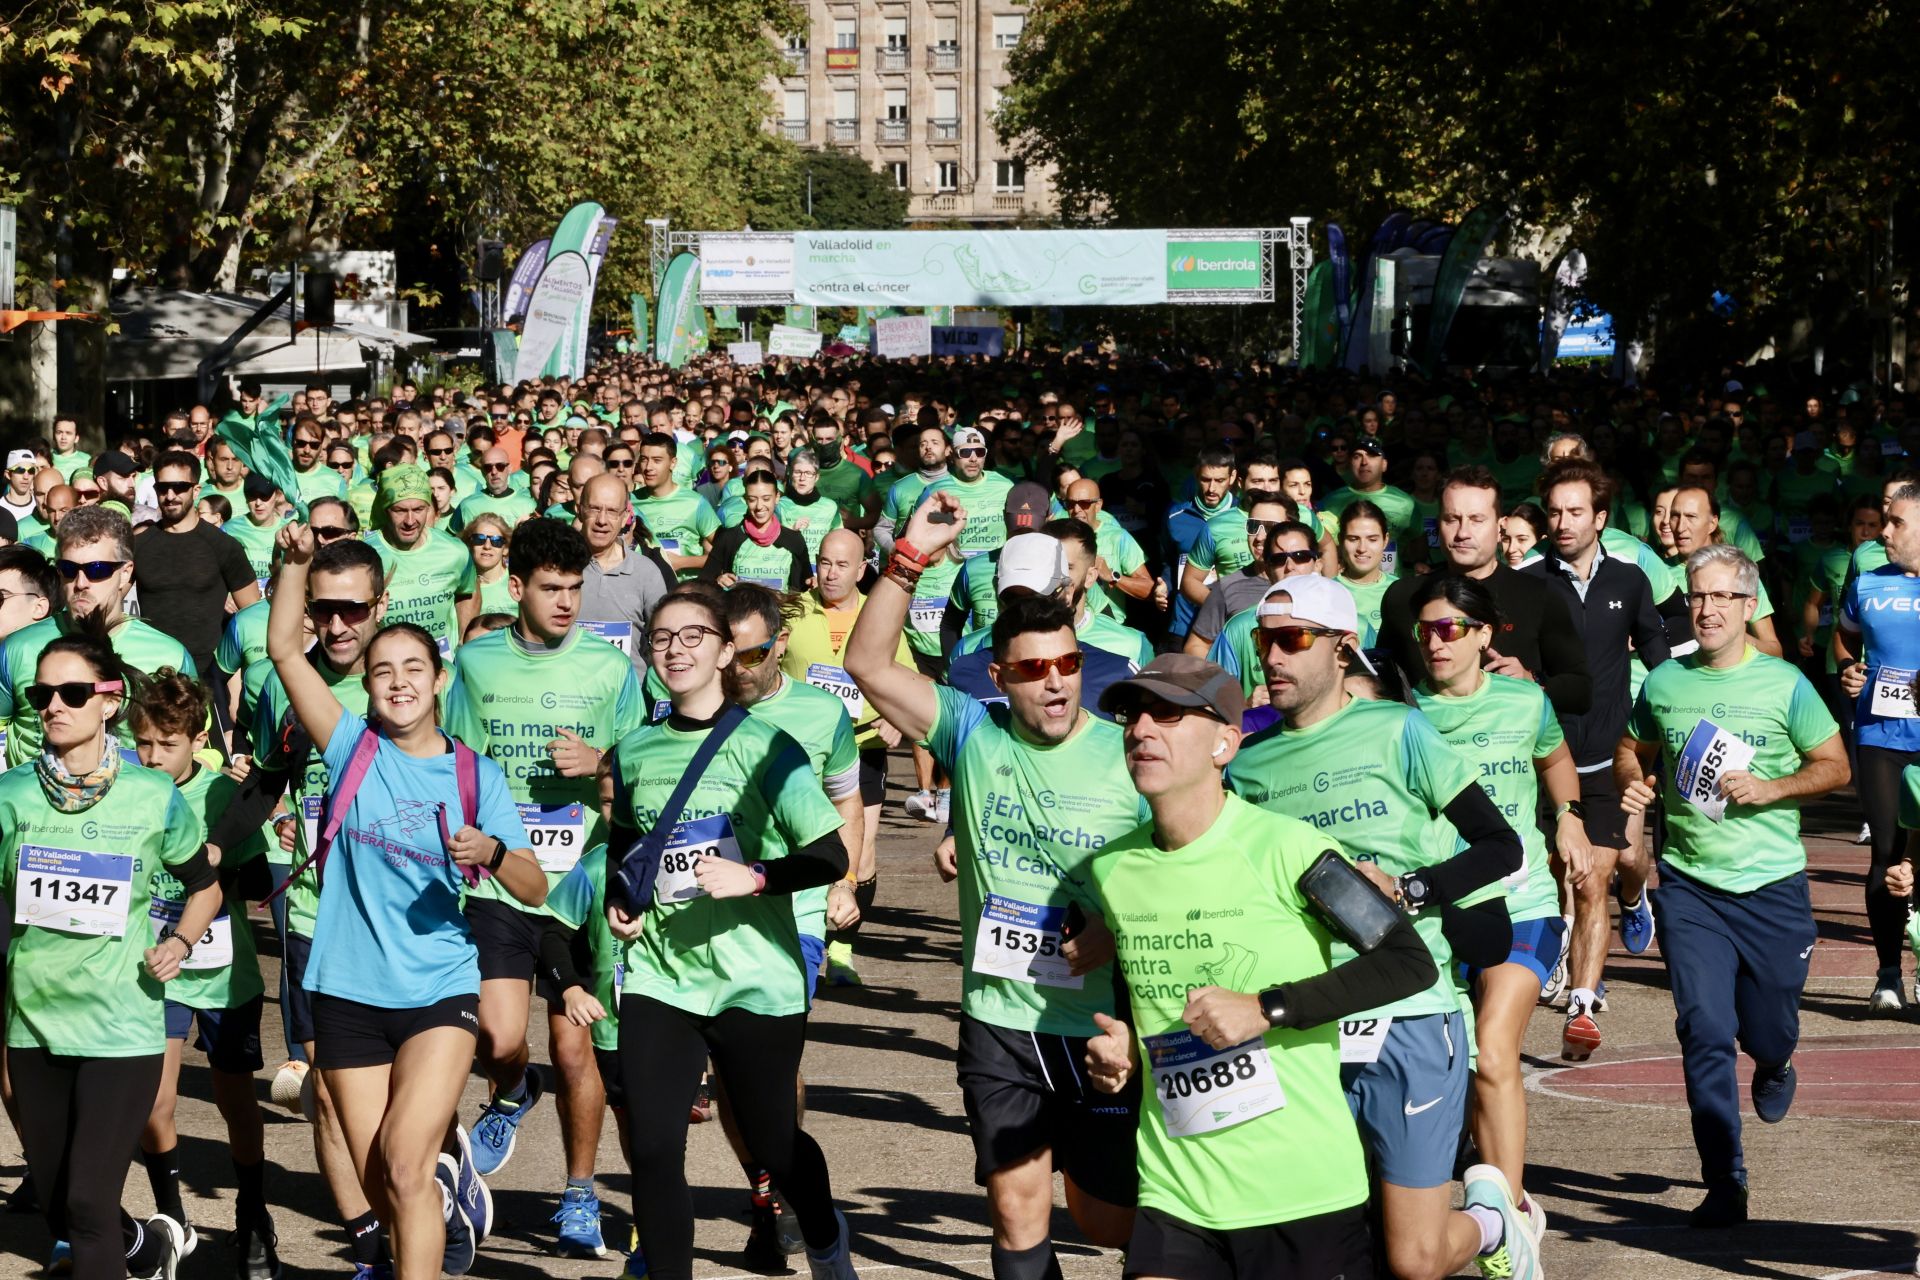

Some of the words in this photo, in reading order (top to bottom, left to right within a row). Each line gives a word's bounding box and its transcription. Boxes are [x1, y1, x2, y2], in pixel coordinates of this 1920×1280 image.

[809, 239, 873, 250] Valladolid
[876, 241, 891, 250] en
[809, 253, 856, 263] marcha
[1197, 258, 1256, 271] Iberdrola
[809, 283, 850, 293] contra
[853, 282, 865, 292] el
[867, 282, 911, 293] cáncer
[490, 719, 514, 737] En
[1666, 727, 1686, 744] En
[1479, 756, 1529, 776] archa
[1695, 739, 1727, 802] 39855
[1270, 782, 1308, 800] Iberdrola
[635, 805, 659, 825] En
[995, 794, 1024, 821] En
[31, 824, 74, 834] Iberdrola
[347, 827, 384, 848] RIBERA
[386, 843, 402, 856] EN
[525, 829, 574, 847] 079
[28, 849, 43, 858] XIV
[43, 850, 81, 862] Valladolid
[37, 857, 62, 865] marcha
[385, 853, 408, 869] 2024
[986, 847, 1009, 868] el
[27, 862, 48, 870] contra
[49, 863, 57, 871] el
[57, 865, 80, 874] cáncer
[30, 877, 118, 905] 11347
[1003, 901, 1039, 915] Valladolid
[1202, 908, 1244, 920] Iberdrola
[988, 910, 1008, 920] contra
[1015, 916, 1037, 926] cáncer
[1122, 913, 1158, 922] Valladolid
[1115, 929, 1128, 950] En
[1133, 929, 1213, 950] marcha
[1121, 956, 1172, 975] ontra
[1338, 1019, 1378, 1036] 02
[1161, 1053, 1256, 1099] 20688
